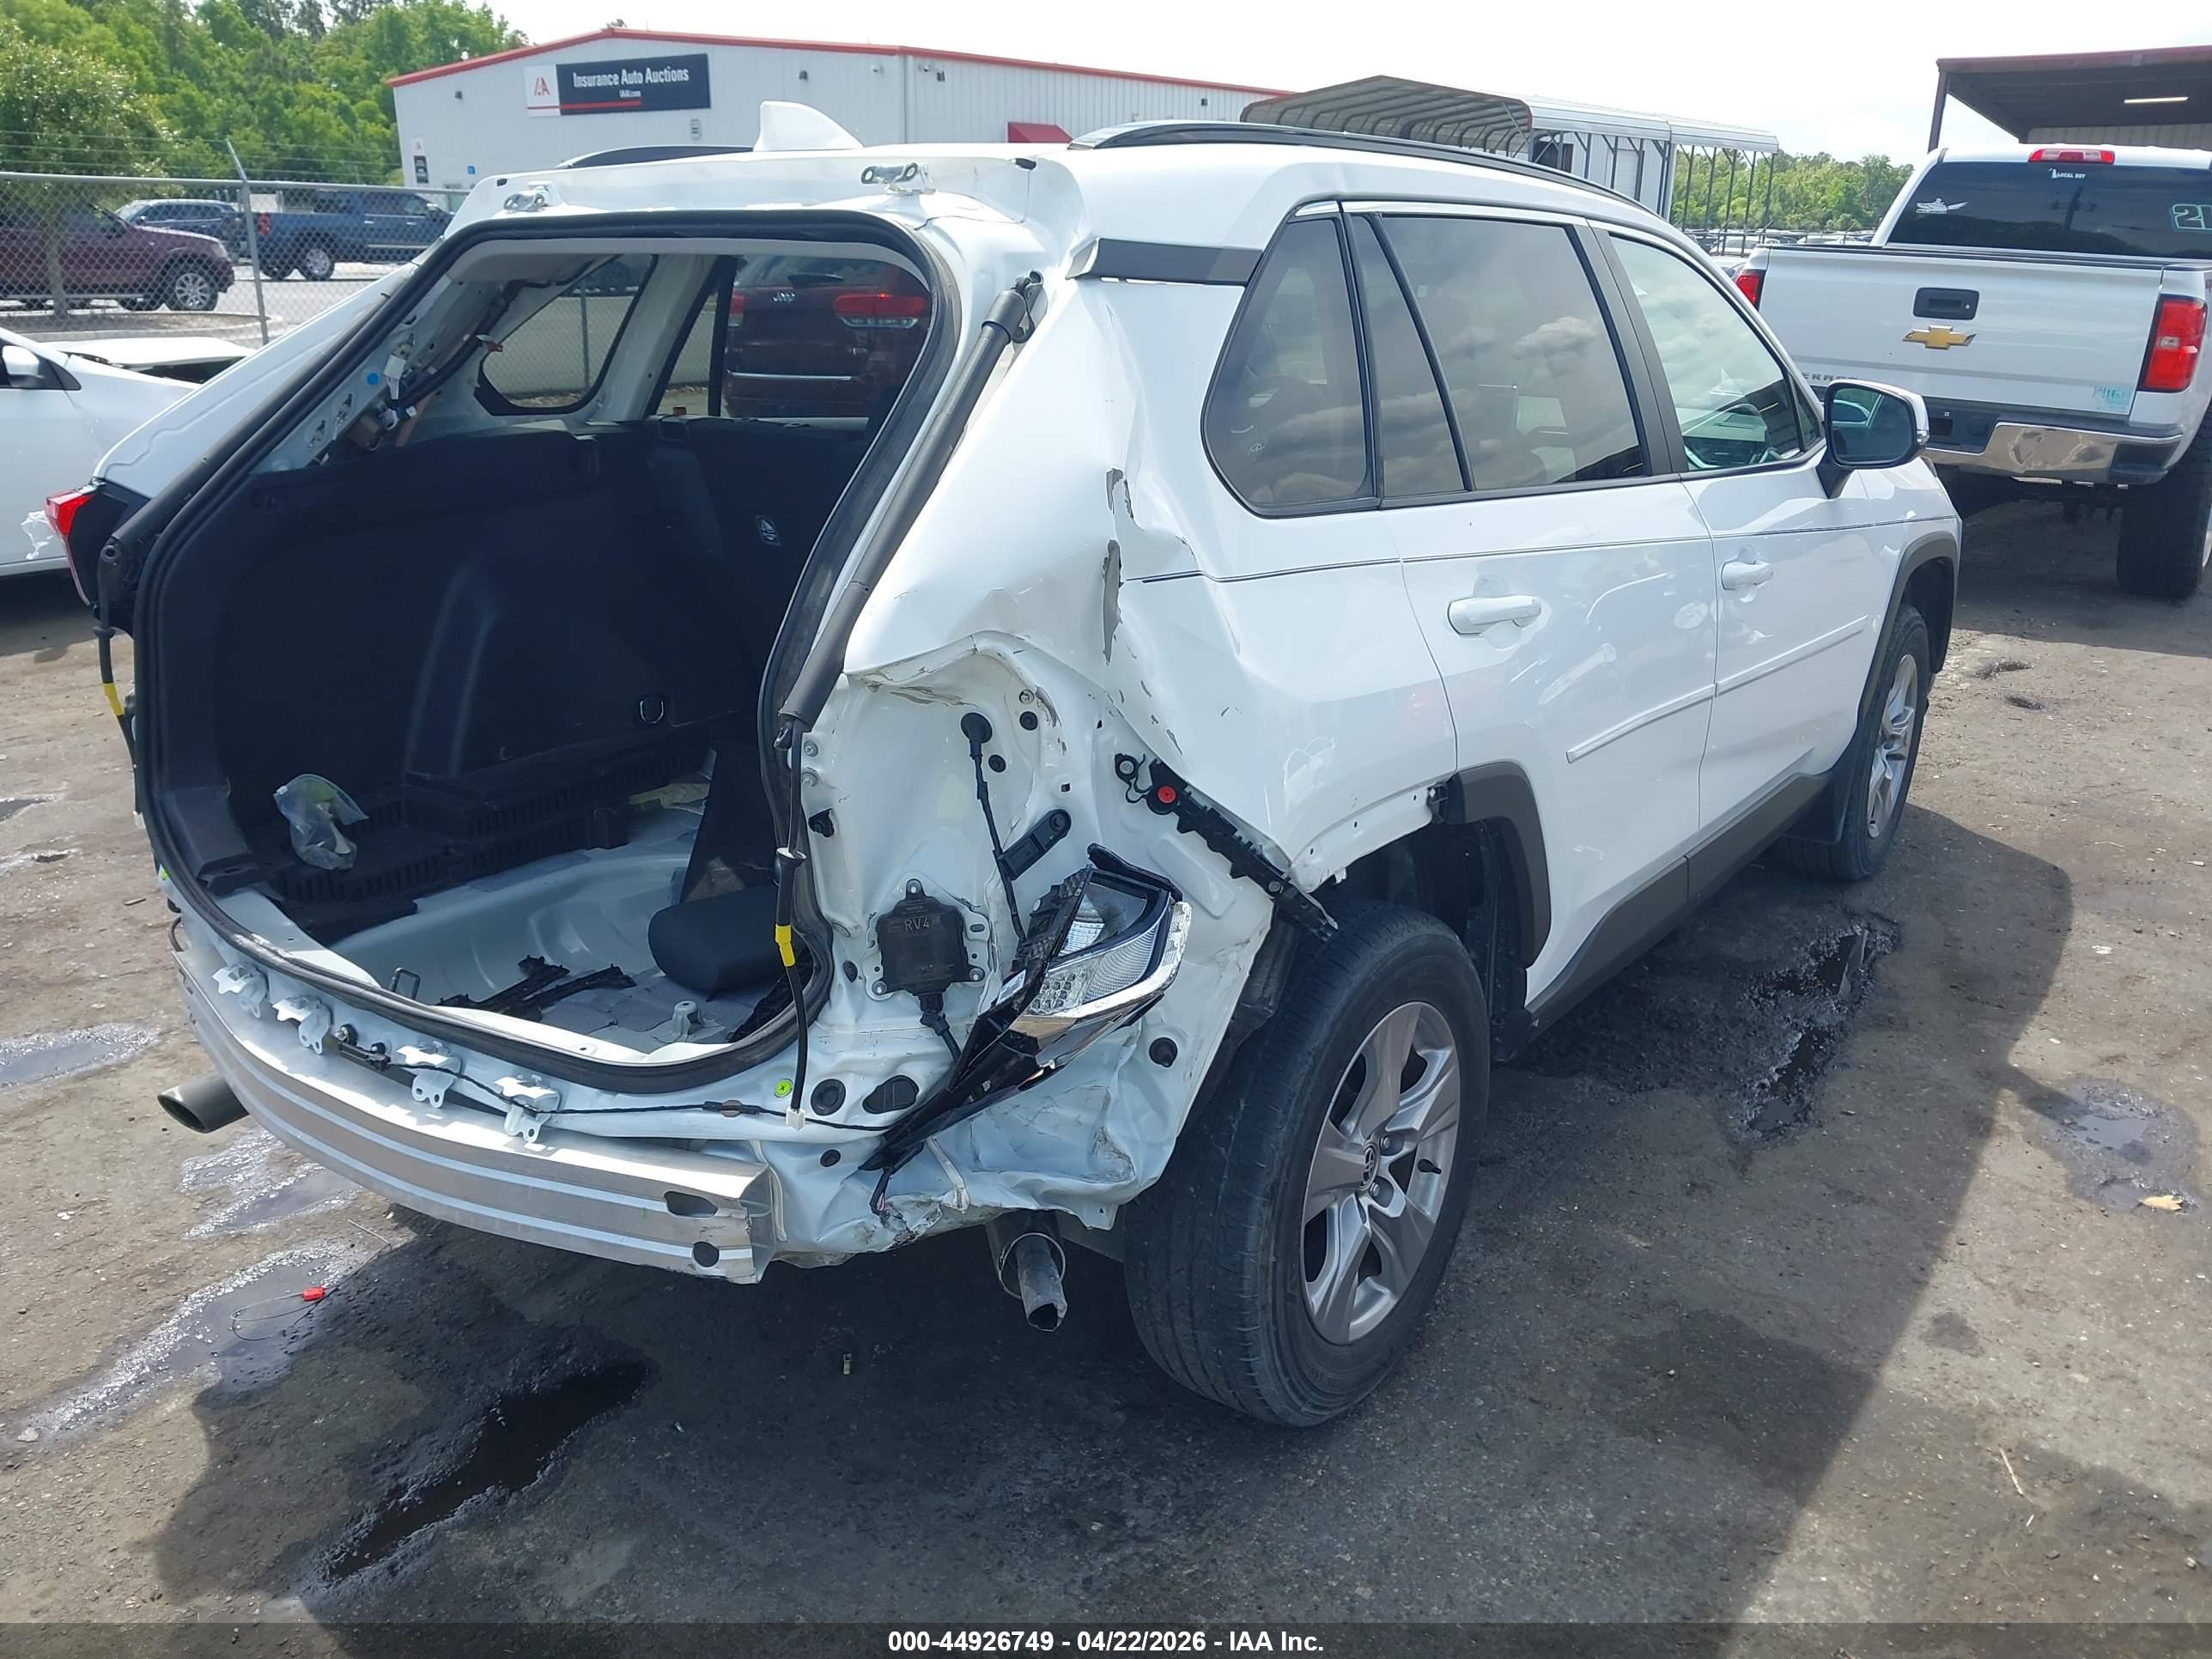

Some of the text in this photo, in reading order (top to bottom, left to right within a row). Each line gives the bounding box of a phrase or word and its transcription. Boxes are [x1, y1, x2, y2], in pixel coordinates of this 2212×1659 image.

[573, 65, 690, 88] Insurance Auto Auctions
[904, 917, 930, 933] RV4
